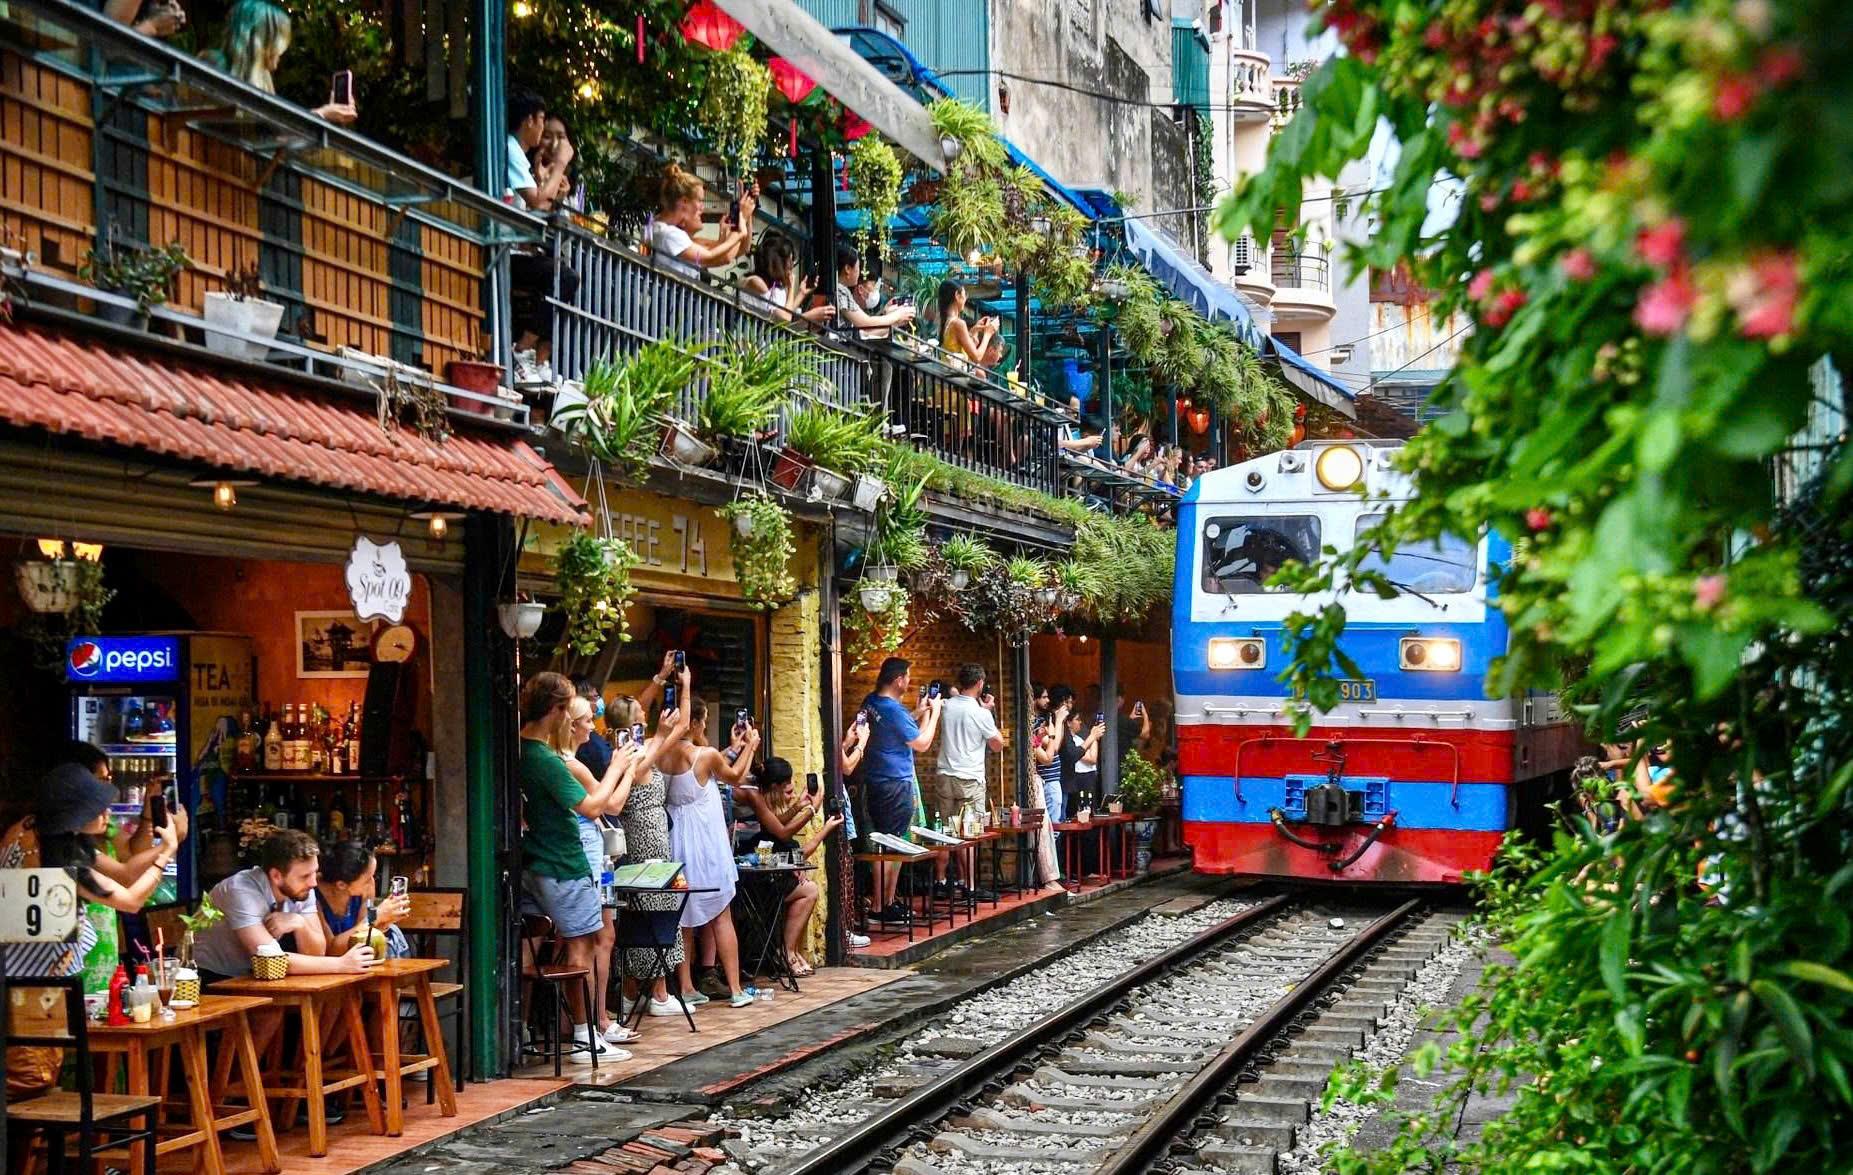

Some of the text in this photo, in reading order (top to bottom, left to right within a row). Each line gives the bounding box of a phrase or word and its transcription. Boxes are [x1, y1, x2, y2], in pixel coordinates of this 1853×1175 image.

[672, 514, 708, 577] 74
[359, 573, 404, 603] Spot 09
[106, 647, 171, 672] pepsi
[193, 663, 231, 690] TEA
